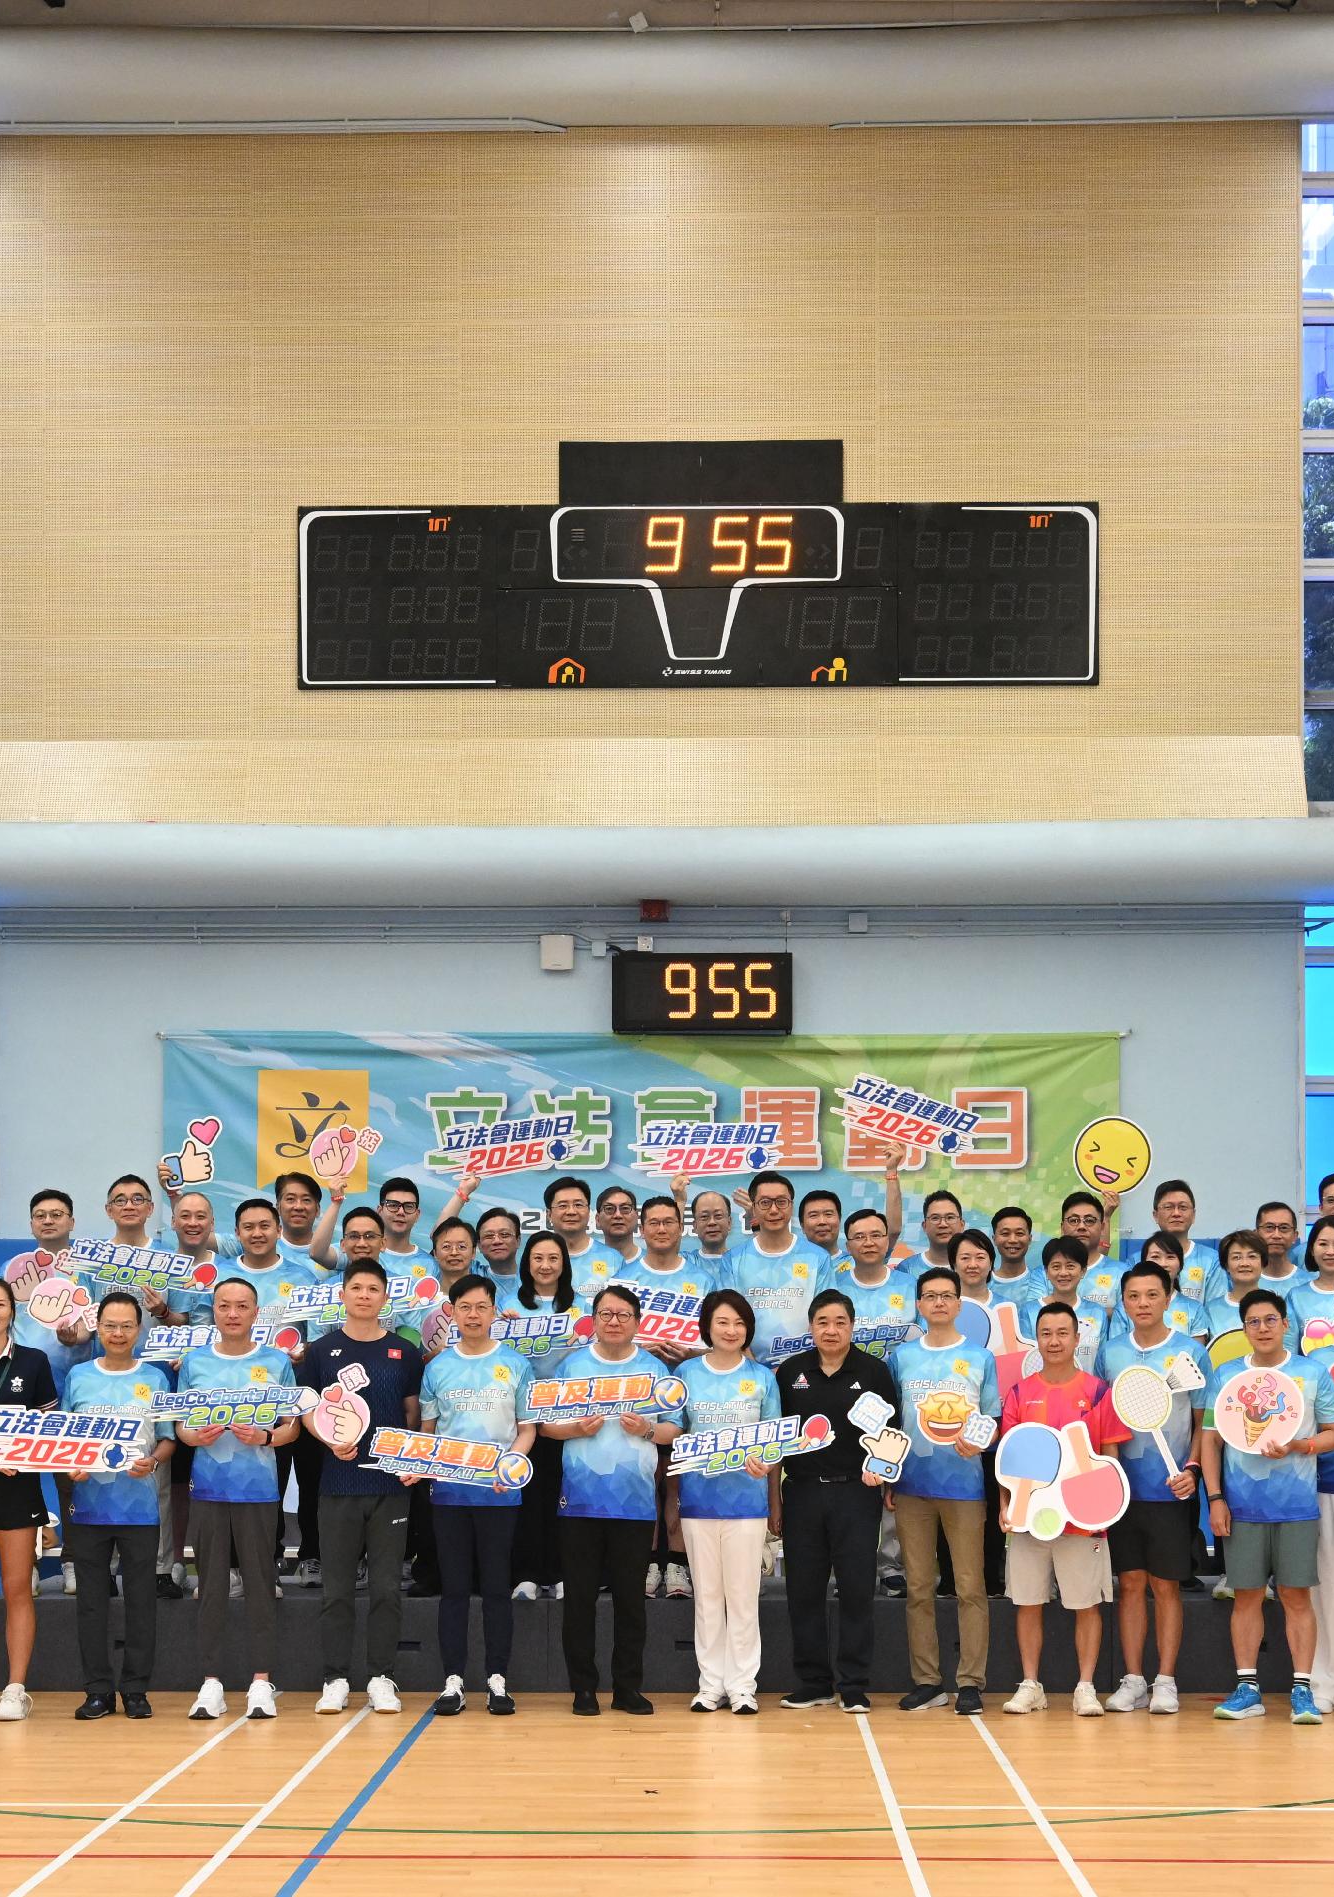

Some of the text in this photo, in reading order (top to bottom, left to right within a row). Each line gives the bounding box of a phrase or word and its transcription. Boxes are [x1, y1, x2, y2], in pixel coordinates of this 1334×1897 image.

[847, 1077, 981, 1131] 立法會運動日
[442, 1115, 574, 1152] 立法會運動日
[642, 1121, 778, 1146] 立法會運動日
[859, 1107, 939, 1145] 2026
[466, 1142, 543, 1174] 2026
[661, 1147, 743, 1172] 2026
[72, 1239, 192, 1278] 立法會運動日
[96, 1263, 170, 1289] 2026
[752, 1300, 794, 1310] COUNCIL
[635, 1313, 700, 1342] 026
[773, 1333, 817, 1354] LegC
[876, 1324, 908, 1341] Day
[153, 1386, 301, 1409] LegCo Sports Day
[444, 1388, 508, 1401] LEGISLATIVE
[530, 1375, 652, 1408] 普及運動
[904, 1379, 969, 1392] LEGISLATIVE
[81, 1405, 148, 1416] LEGISLATIVE
[186, 1402, 278, 1428] 2026
[454, 1401, 496, 1412] COUNCIL
[540, 1401, 632, 1420] Sports For All
[689, 1400, 752, 1411] LEGISLATIVE
[697, 1413, 742, 1424] COUNCIL
[373, 1430, 502, 1471] 普及運動
[671, 1418, 798, 1457] 立法會運動日
[4, 1438, 103, 1466] 2026
[706, 1442, 782, 1473] 2026
[380, 1457, 475, 1480] Sports For All
